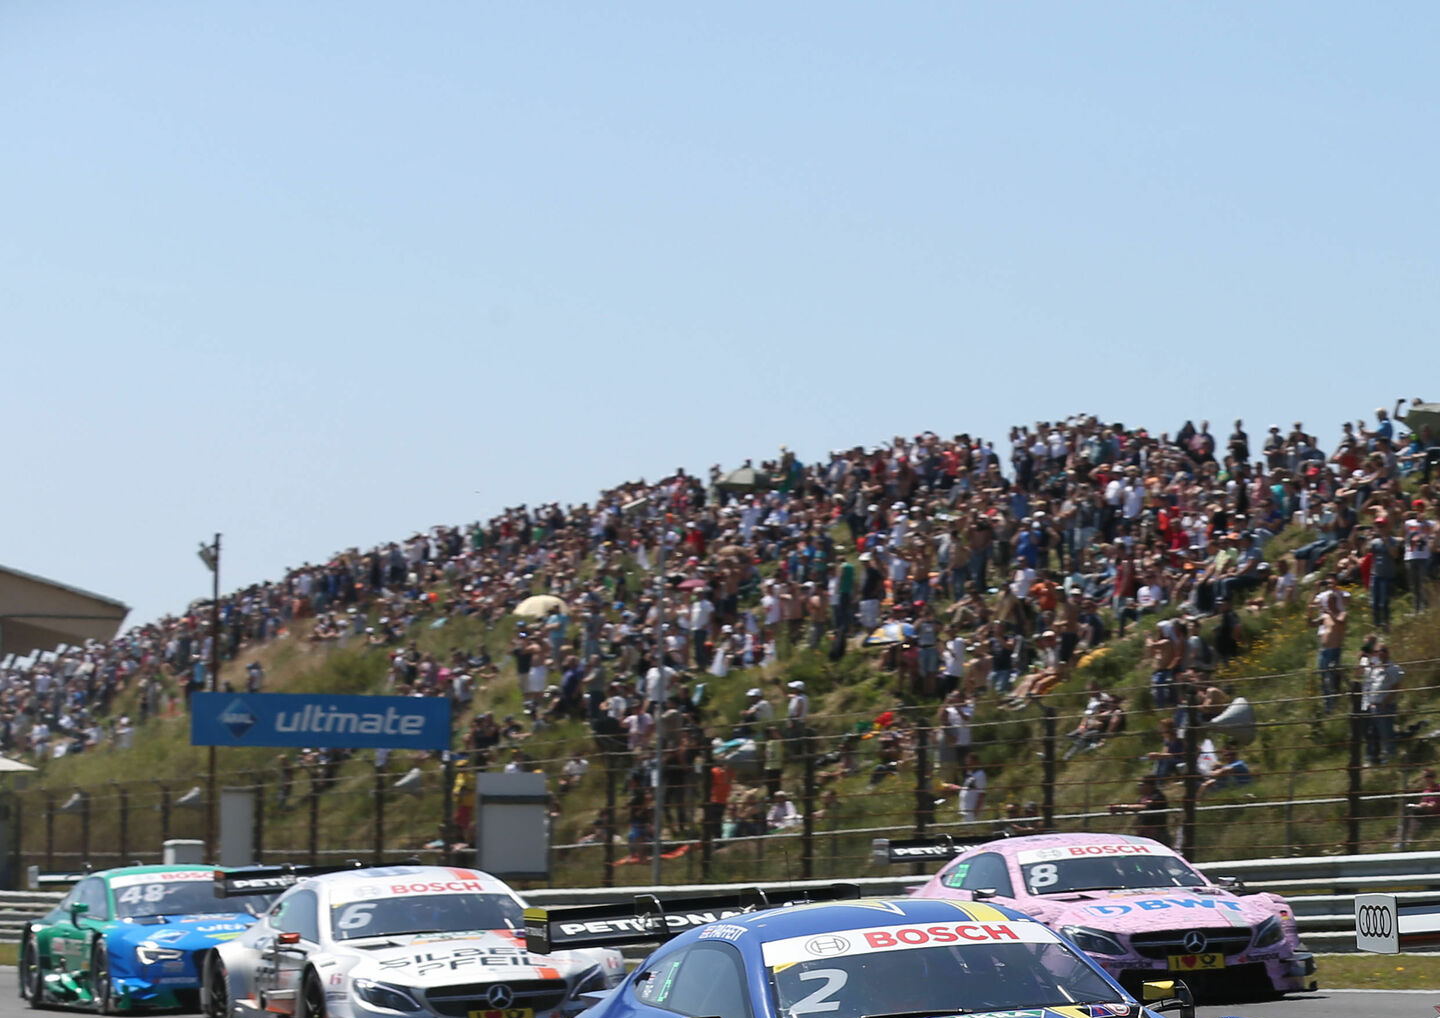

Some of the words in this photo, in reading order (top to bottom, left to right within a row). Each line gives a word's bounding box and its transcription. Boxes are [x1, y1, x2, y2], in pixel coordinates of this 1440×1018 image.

[275, 704, 425, 735] ultimate
[1068, 845, 1151, 857] BOSCH
[162, 872, 214, 880] BOSC
[1029, 864, 1058, 887] 8
[119, 884, 165, 904] 48
[391, 882, 484, 894] BOSCH
[338, 903, 377, 930] 6
[1134, 899, 1243, 912] BWT
[560, 911, 741, 936] PETONA
[863, 924, 1020, 949] BOSCH
[789, 968, 849, 1015] 2
